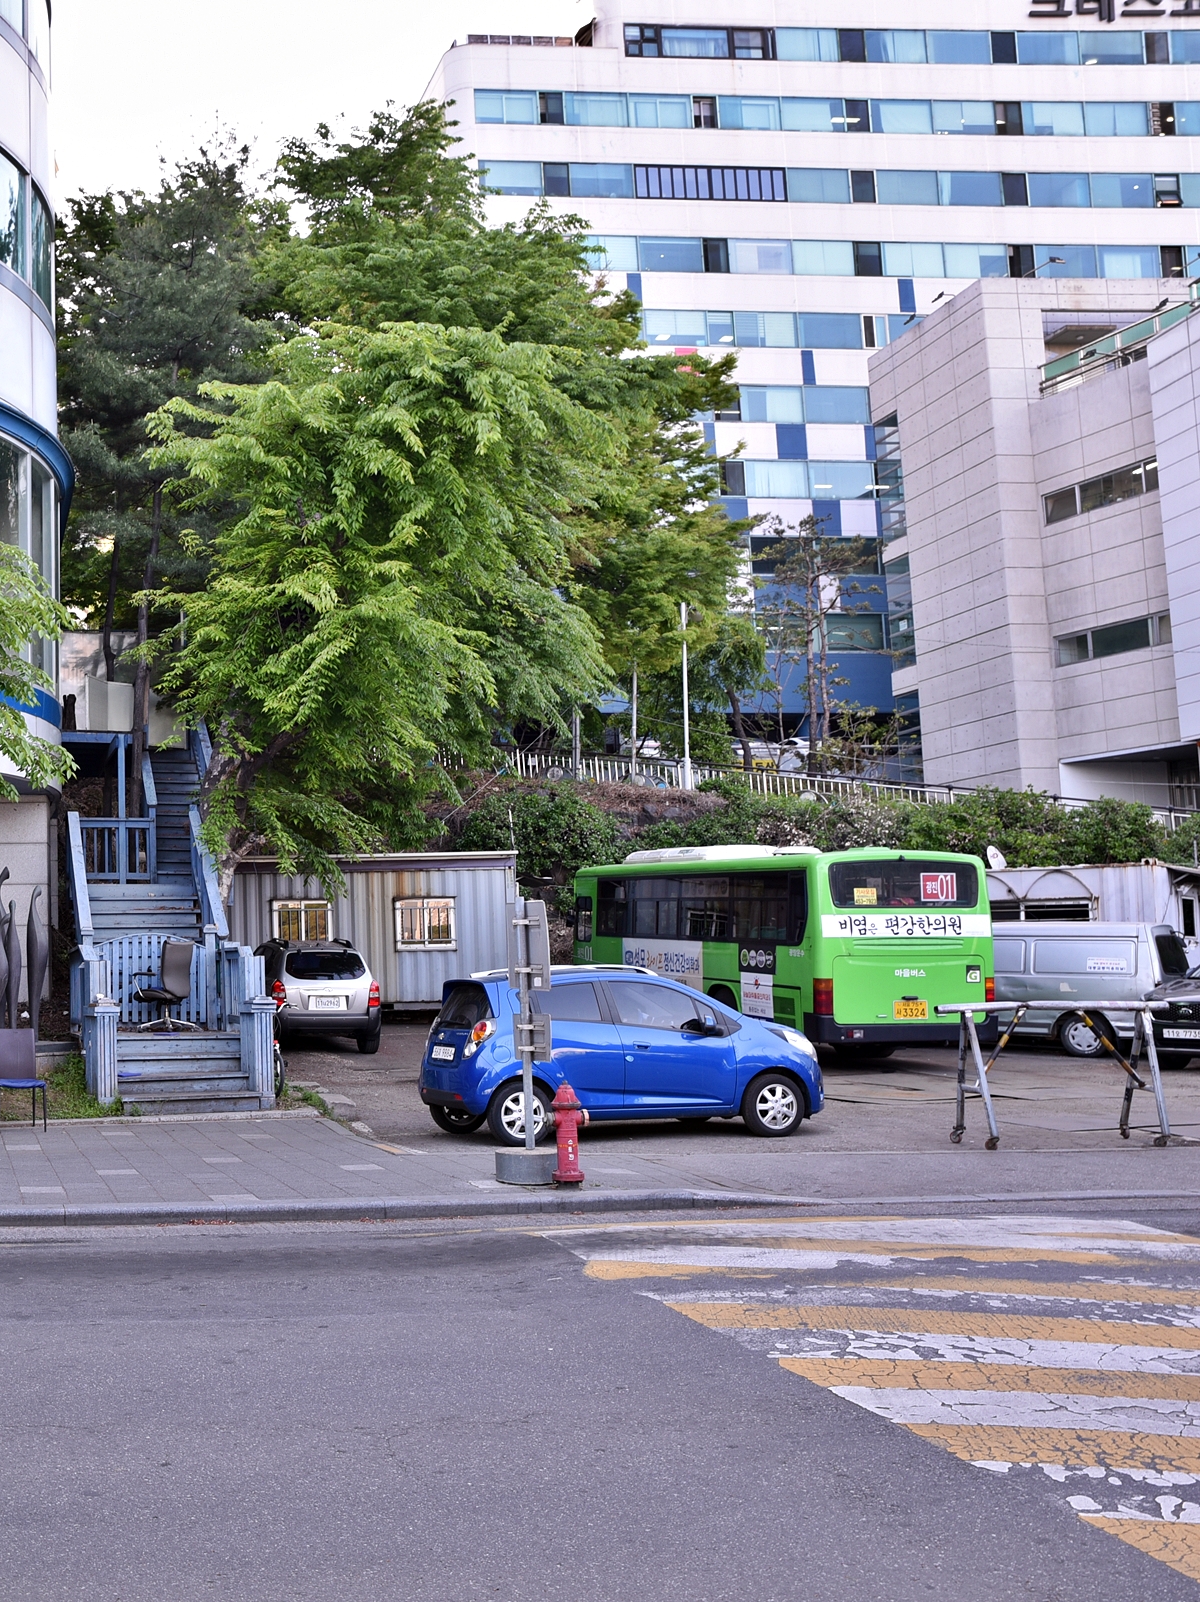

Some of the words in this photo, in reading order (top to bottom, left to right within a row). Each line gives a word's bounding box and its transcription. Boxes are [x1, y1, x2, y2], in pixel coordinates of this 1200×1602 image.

[938, 875, 952, 900] 01
[839, 915, 878, 936] 비염은
[885, 915, 962, 936] 편강한의원
[664, 952, 700, 973] 정신건강의학과
[894, 969, 926, 978] 마을버스
[903, 1008, 926, 1018] 3324
